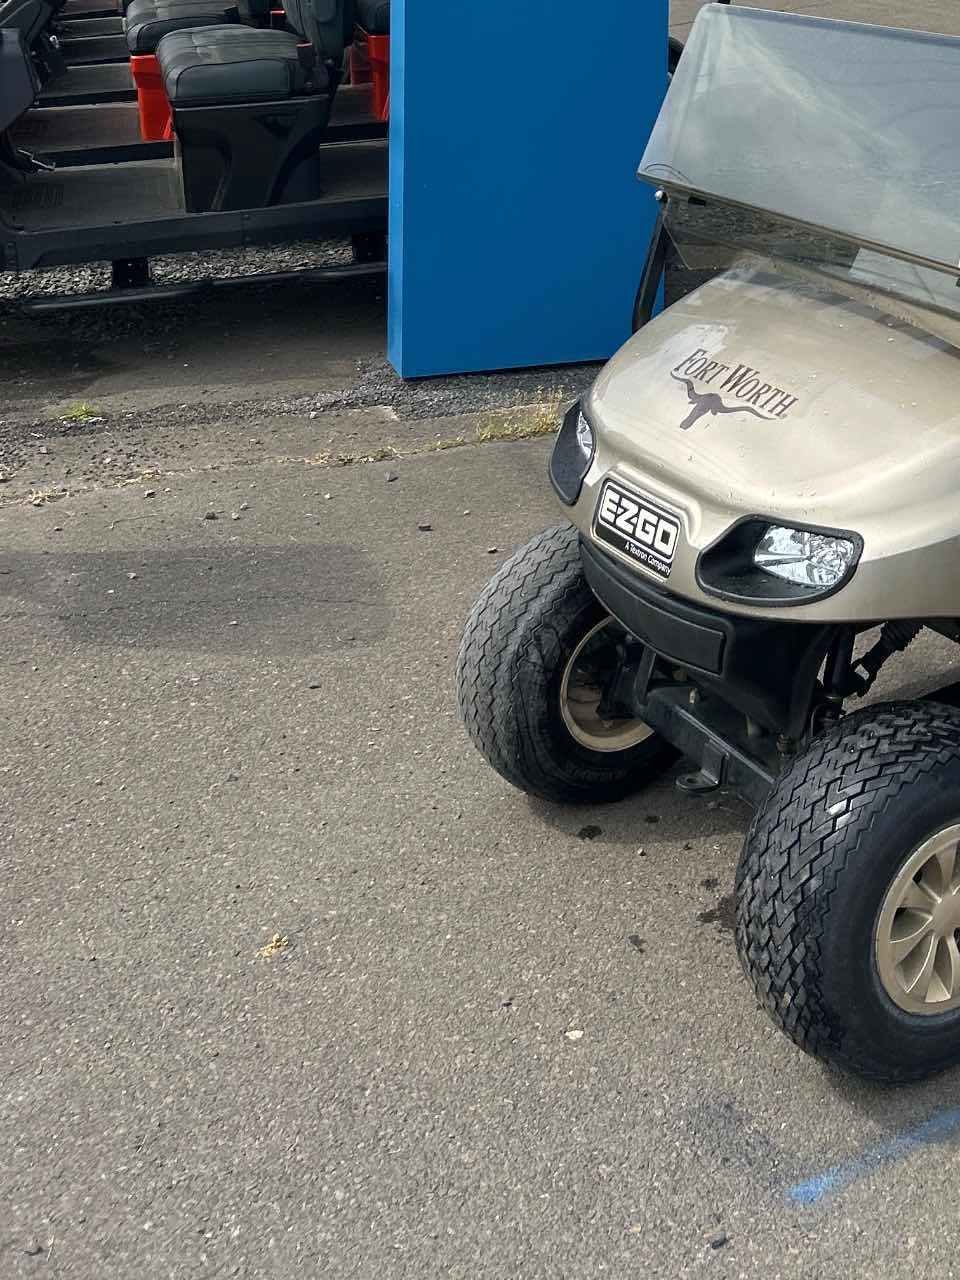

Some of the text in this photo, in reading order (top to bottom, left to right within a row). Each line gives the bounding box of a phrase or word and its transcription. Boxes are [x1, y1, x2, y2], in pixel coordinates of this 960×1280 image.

[673, 348, 799, 417] FORT WORTH
[624, 541, 671, 576] A Textron Company
